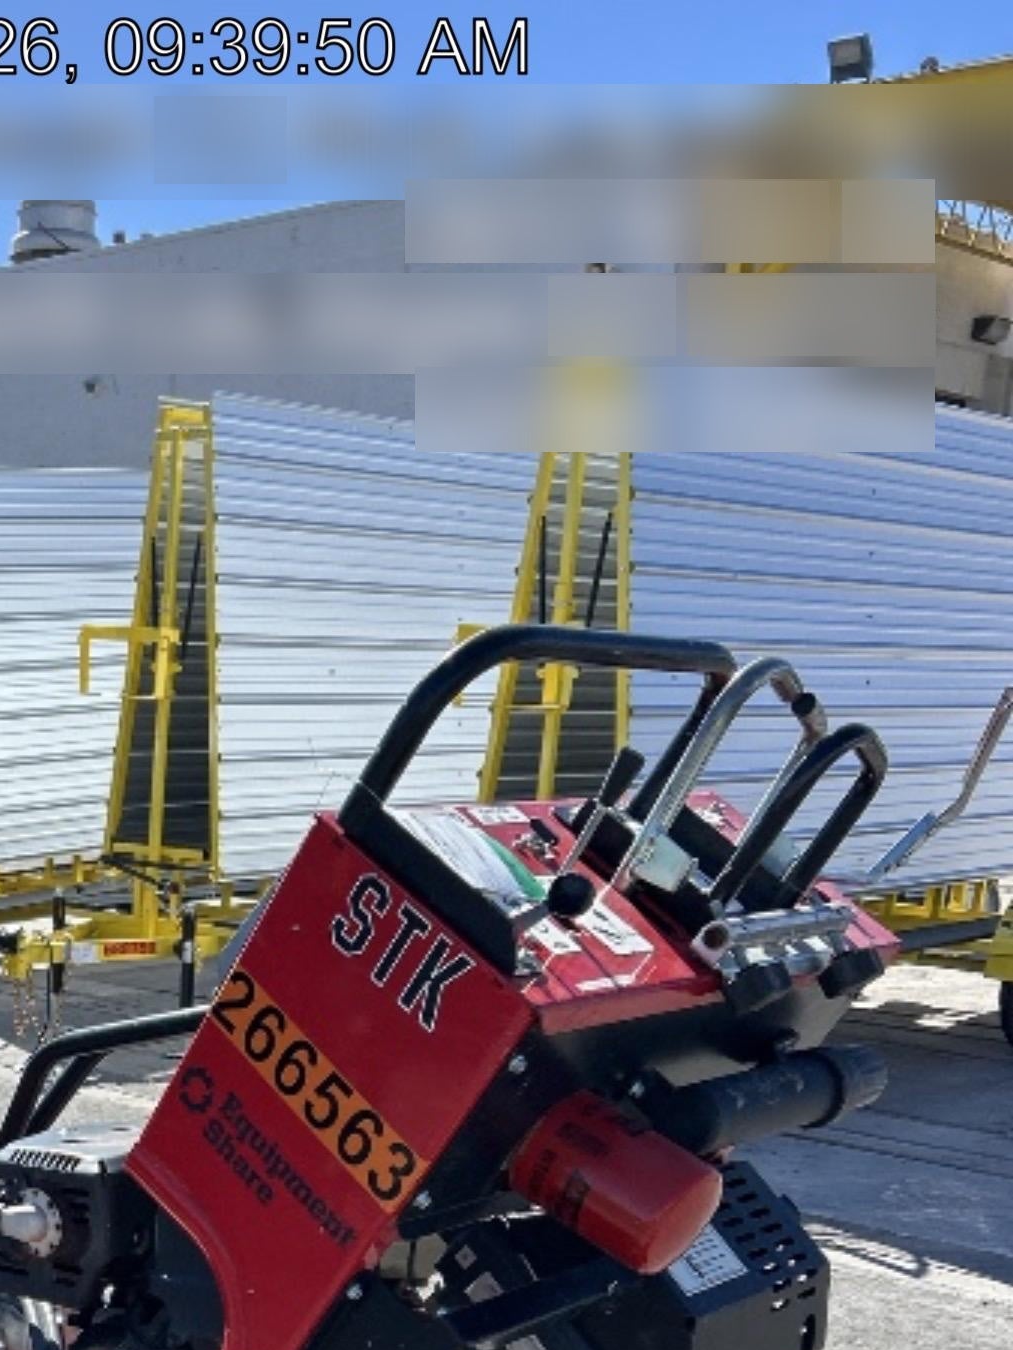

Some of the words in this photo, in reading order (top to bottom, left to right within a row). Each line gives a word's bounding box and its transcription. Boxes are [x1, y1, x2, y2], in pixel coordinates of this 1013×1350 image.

[330, 872, 477, 1033] STK
[202, 1117, 275, 1208] Share
[211, 970, 417, 1202] 266563
[218, 1092, 356, 1246] Equipment
